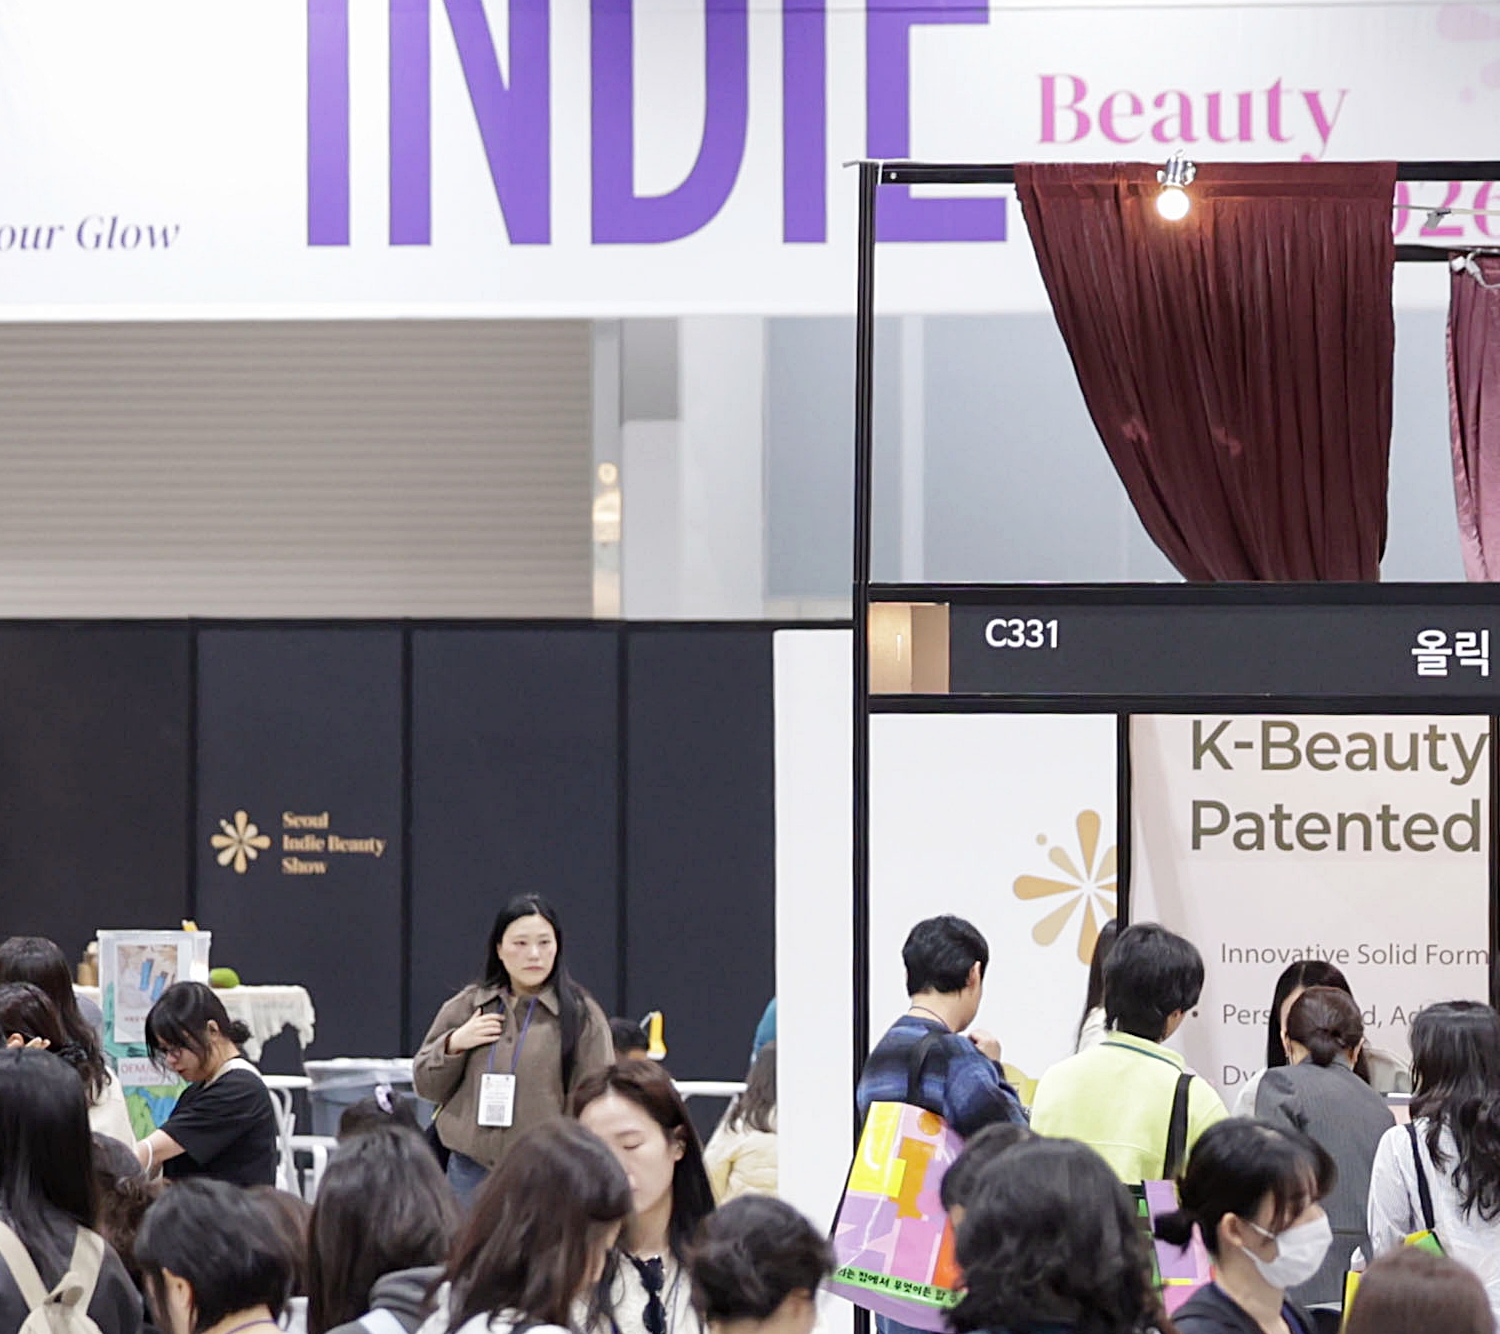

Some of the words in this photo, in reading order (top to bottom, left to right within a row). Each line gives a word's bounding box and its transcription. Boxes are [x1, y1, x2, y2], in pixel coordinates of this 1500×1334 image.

[1037, 72, 1350, 162] Beauty
[75, 214, 181, 251] Glow
[984, 618, 1059, 649] C331
[1411, 629, 1490, 677] 올릭
[1191, 719, 1490, 787] K-Beauty
[282, 810, 329, 829] Seoul
[1190, 798, 1482, 853] Patented
[327, 834, 386, 858] Beauty
[281, 857, 328, 874] Show
[1221, 942, 1350, 966] Innovative
[1357, 941, 1419, 966] Solid
[1425, 942, 1490, 966] Form
